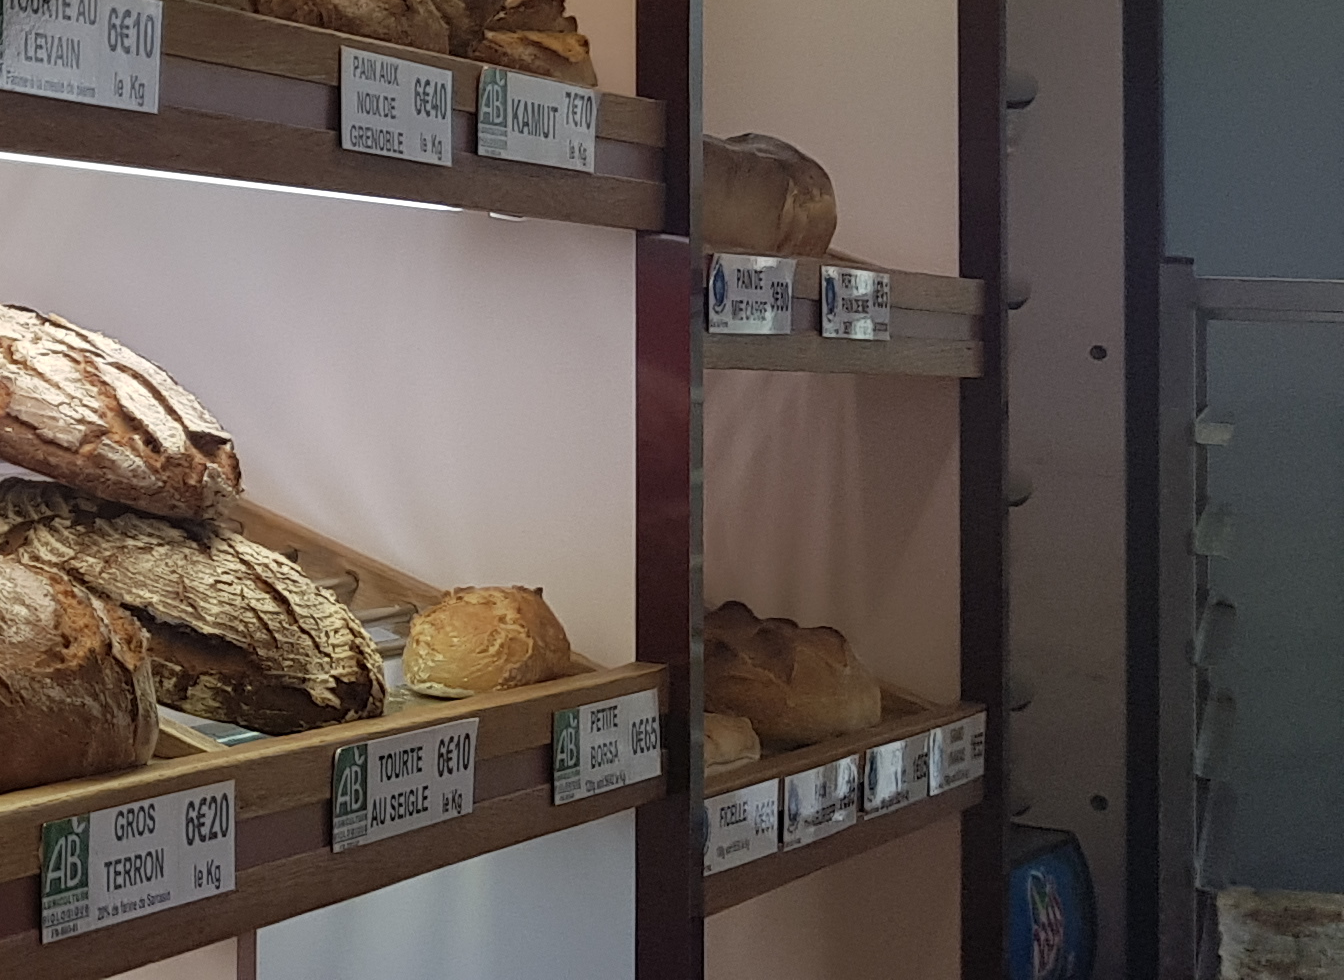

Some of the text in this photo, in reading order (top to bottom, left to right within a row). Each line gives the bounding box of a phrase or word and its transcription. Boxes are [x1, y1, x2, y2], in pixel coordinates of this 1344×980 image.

[23, 31, 81, 70] LEVAIN
[107, 7, 155, 59] 6€10
[113, 72, 124, 97] le
[129, 75, 145, 107] Kg
[353, 55, 399, 87] PAIN AUX
[357, 90, 397, 120] NOIX DE
[414, 77, 448, 120] 6€40
[480, 83, 503, 124] AB
[565, 91, 593, 130] 7€70
[512, 97, 559, 140] KAMUT
[350, 124, 404, 155] GRENOBLE
[431, 134, 442, 160] Kg
[591, 705, 618, 732] PETITE
[632, 716, 658, 756] 0€65
[378, 746, 423, 783] TOURTE
[436, 732, 471, 778] 6€10
[556, 728, 577, 768] AB
[336, 767, 362, 816] AB
[370, 796, 387, 828] AU
[389, 785, 429, 822] SEIGLE
[442, 788, 463, 816] le Kg
[114, 803, 156, 842] GROS
[185, 792, 229, 846] 6€20
[45, 834, 82, 894] AB
[104, 848, 164, 893] TERRON
[193, 859, 221, 890] le Kg
